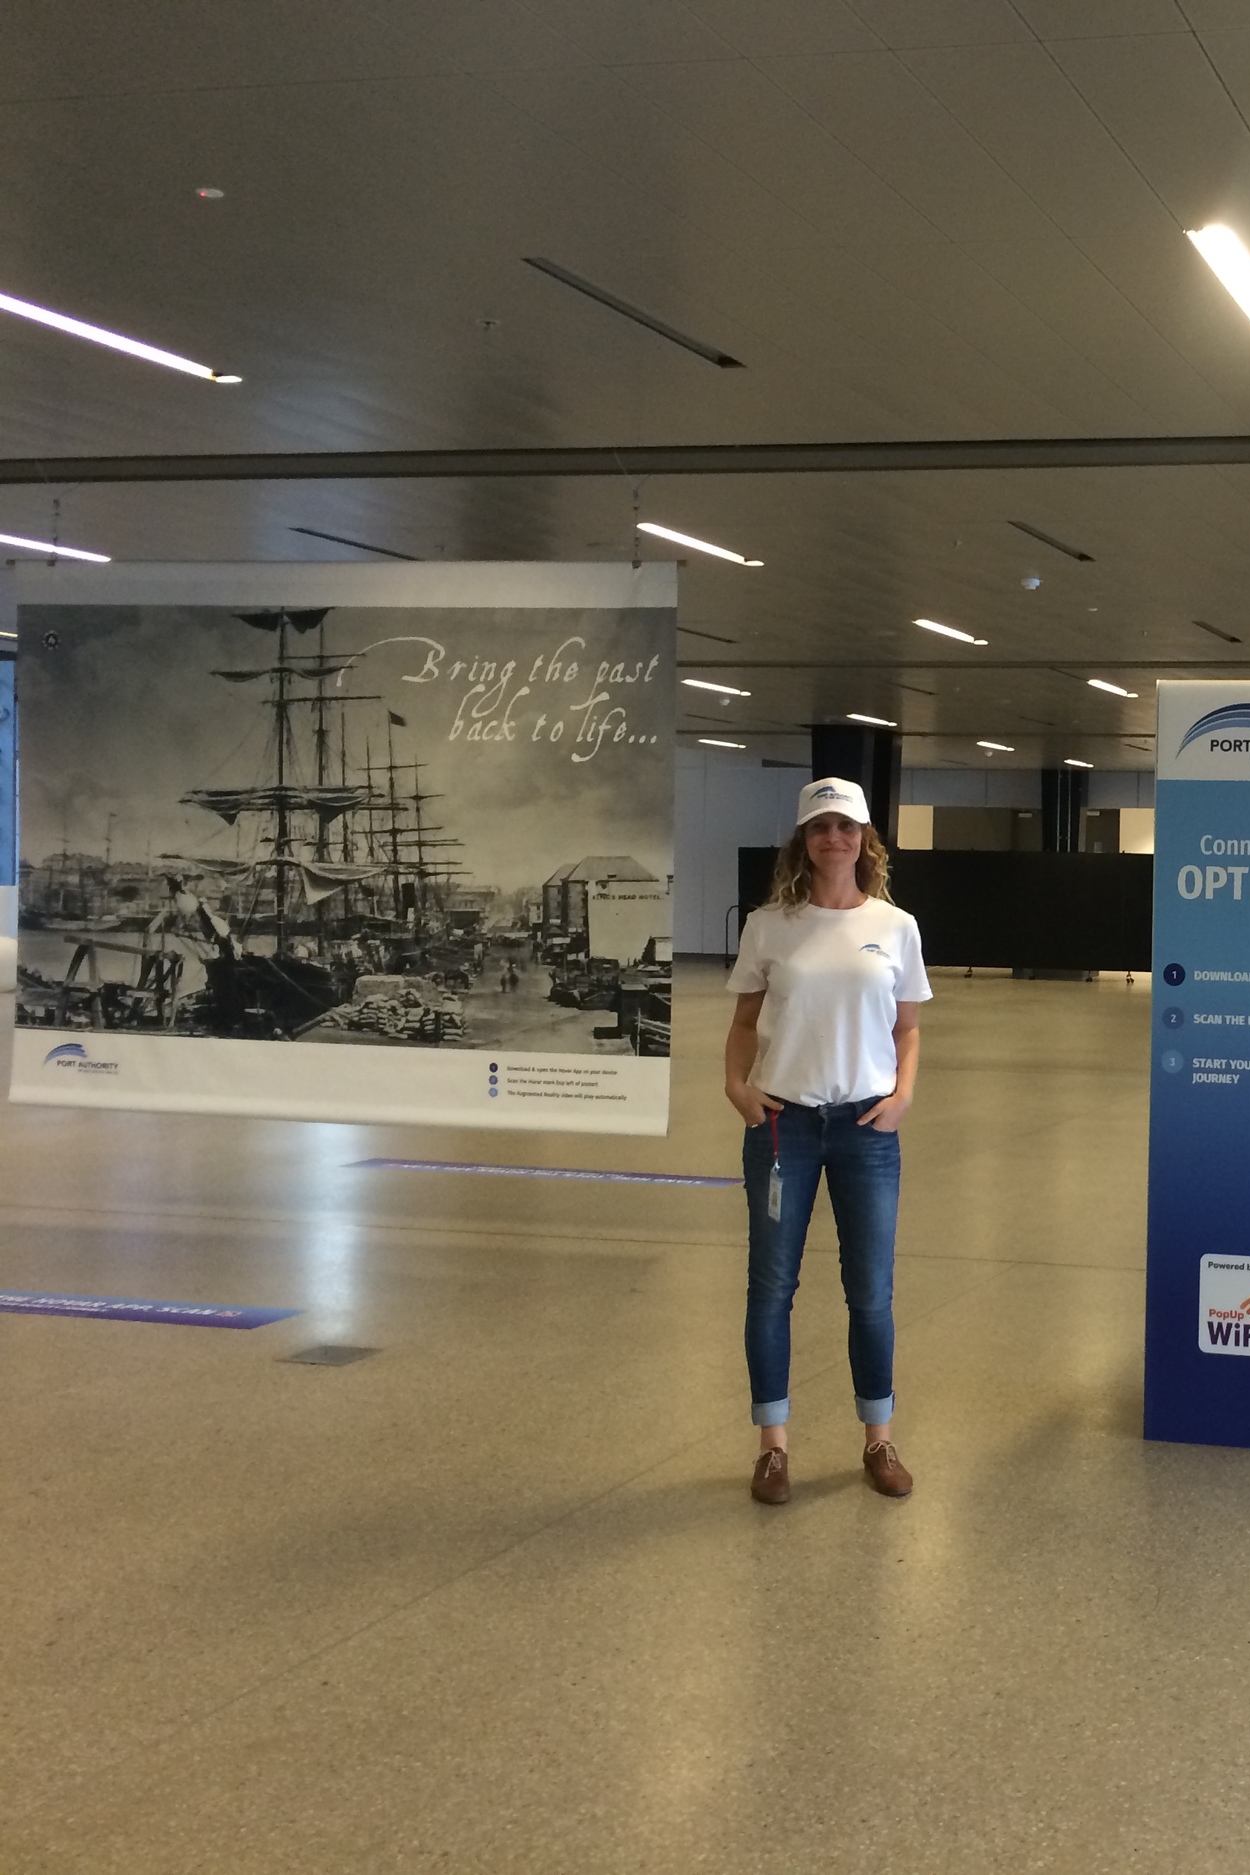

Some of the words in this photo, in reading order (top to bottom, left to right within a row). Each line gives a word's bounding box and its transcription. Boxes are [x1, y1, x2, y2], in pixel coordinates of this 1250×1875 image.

[528, 637, 585, 683] the
[592, 654, 660, 696] past
[449, 684, 530, 742] back
[531, 714, 564, 743] to
[570, 692, 658, 763] life...
[1177, 864, 1249, 900] OPT
[1172, 971, 1177, 979] 1
[1170, 1014, 1177, 1023] 2
[1193, 1014, 1222, 1025] SCAN
[1225, 1015, 1245, 1025] THE
[78, 1061, 118, 1069] AUTHORITY
[1169, 1058, 1175, 1066] 3
[1193, 1058, 1227, 1069] START
[1192, 1072, 1240, 1085] JOURNEY
[1208, 1261, 1245, 1271] Powered
[1209, 1309, 1245, 1321] PopUp
